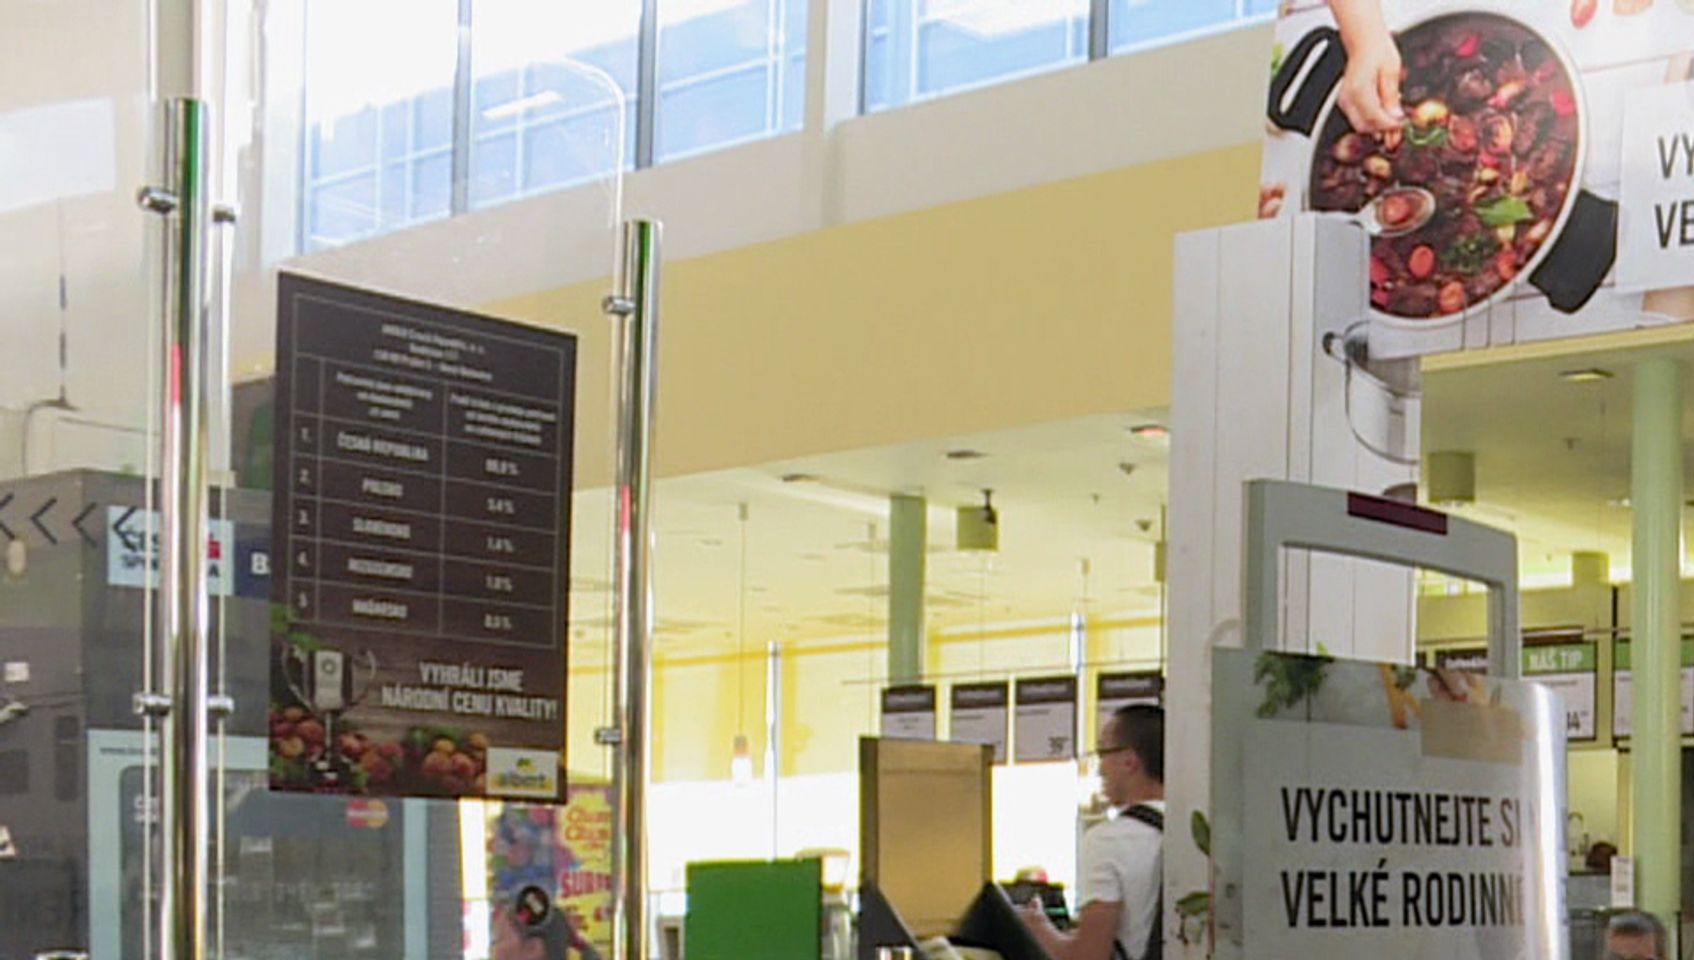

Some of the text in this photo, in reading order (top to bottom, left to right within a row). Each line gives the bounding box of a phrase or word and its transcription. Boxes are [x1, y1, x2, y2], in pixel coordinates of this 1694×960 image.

[419, 656, 524, 692] VYHRÁLI JSME
[1561, 651, 1583, 669] TIP
[382, 682, 558, 719] NÁRODNÍ CENU KVALITY!
[1281, 787, 1493, 847] VYCHUTNEJTE
[1500, 797, 1521, 847] SI
[1281, 858, 1390, 927] VELKÉ
